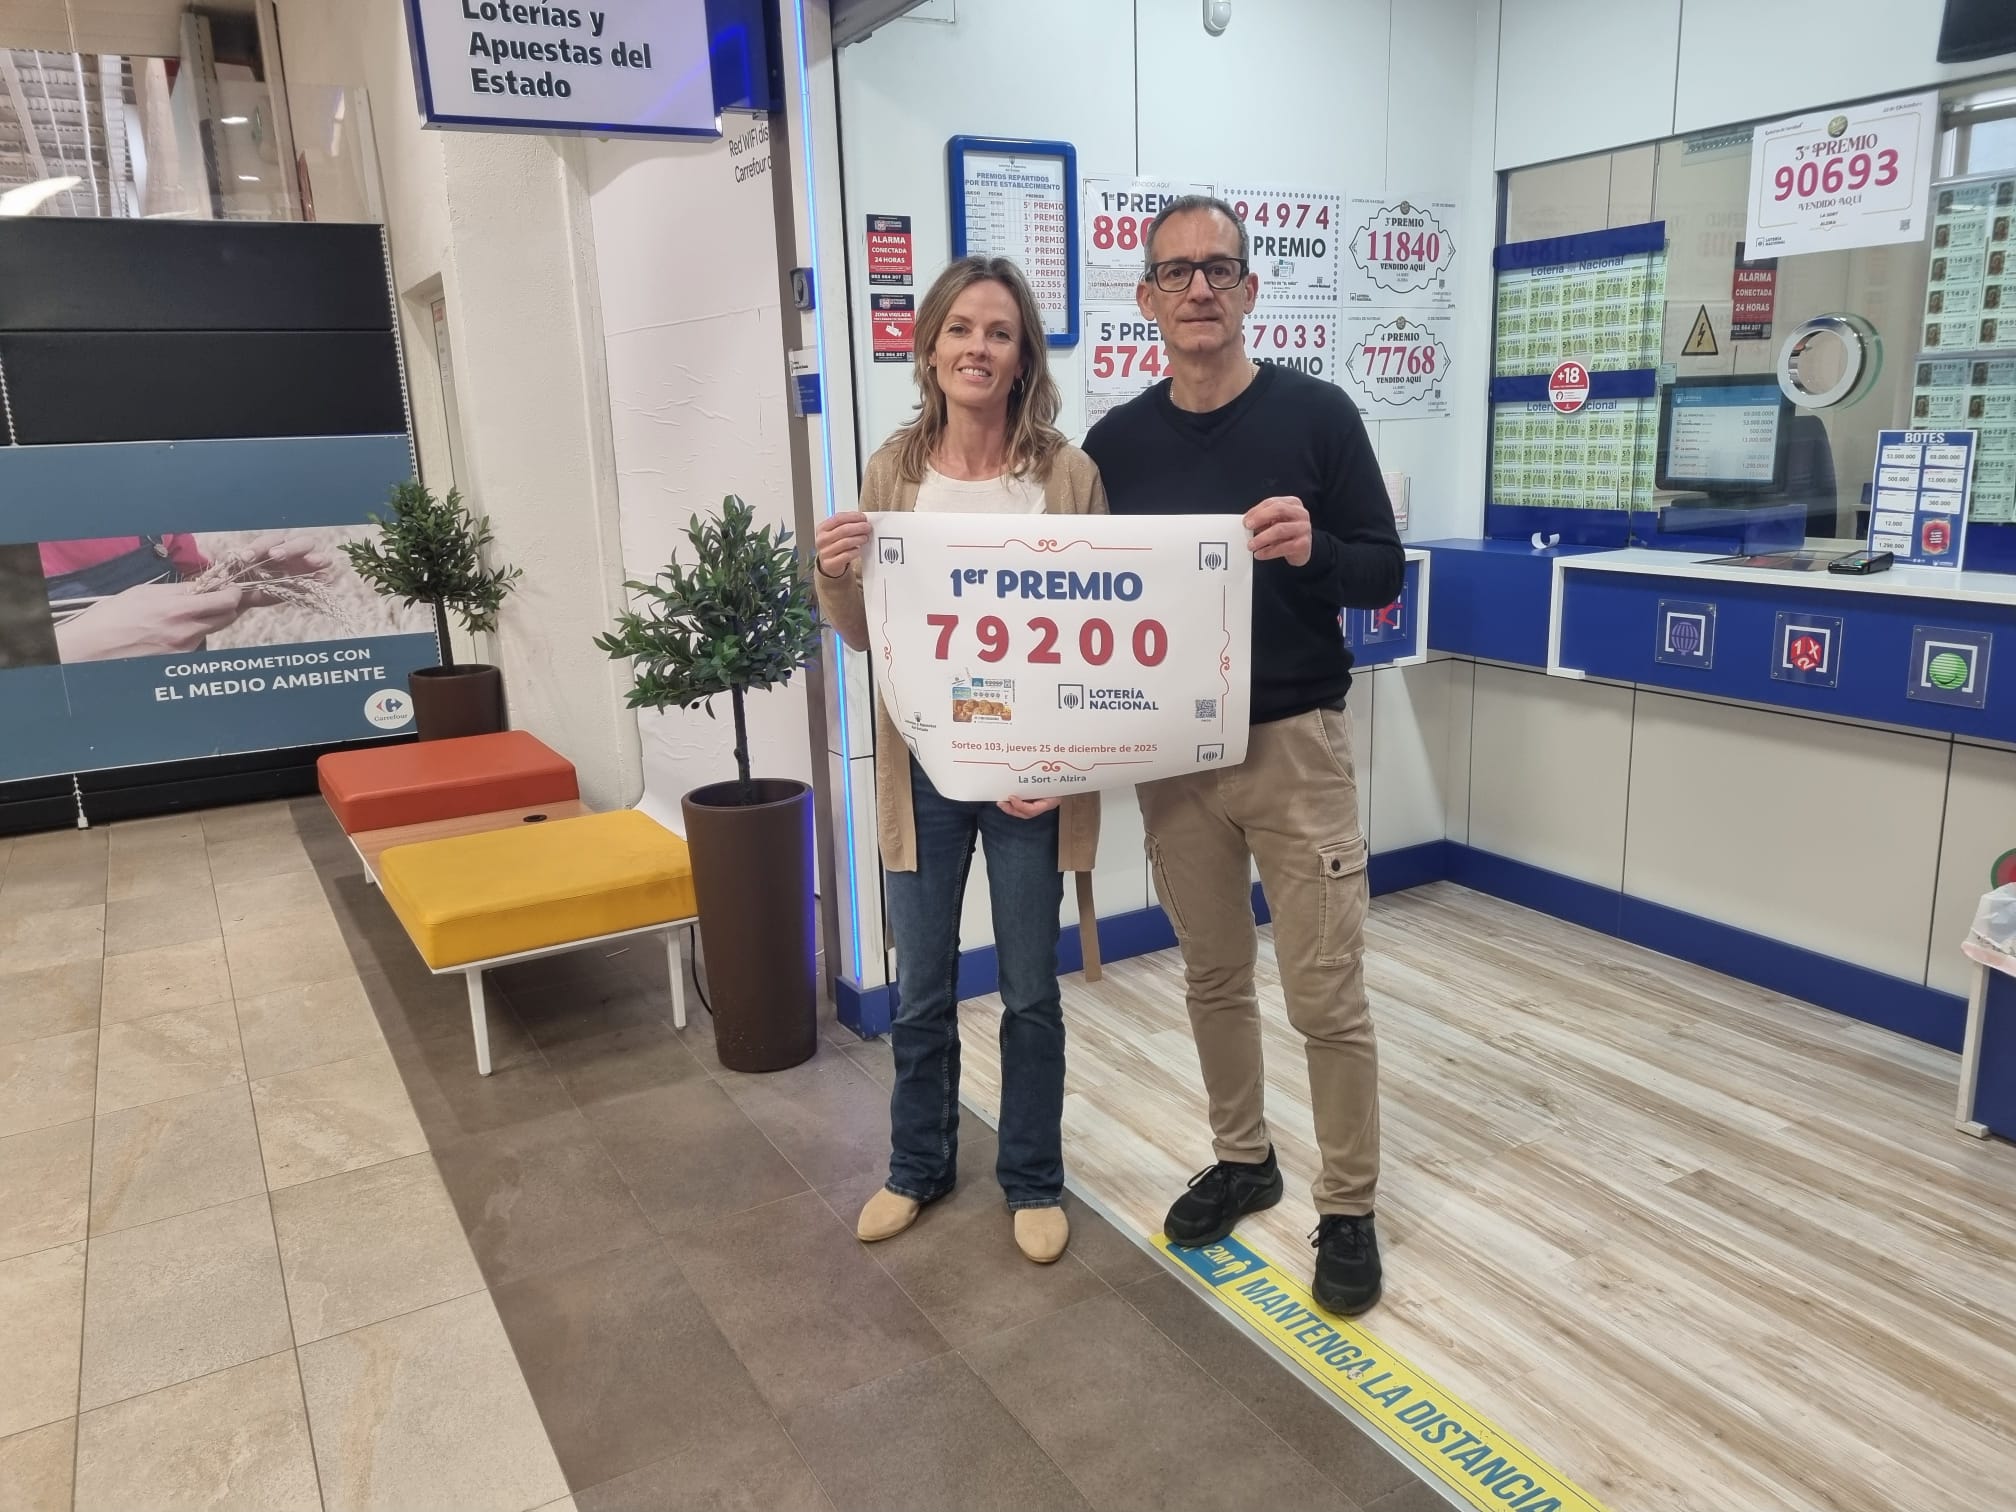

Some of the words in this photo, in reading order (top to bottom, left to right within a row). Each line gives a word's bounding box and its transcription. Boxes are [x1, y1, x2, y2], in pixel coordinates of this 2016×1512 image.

[462, 0, 582, 28] Loterías
[590, 10, 605, 36] y
[469, 31, 603, 65] Apuestas
[611, 42, 653, 69] del
[471, 68, 572, 98] Estado
[728, 133, 743, 158] Red
[1812, 133, 1878, 158] PREMIO
[735, 156, 767, 184] Carrefour
[1774, 148, 1899, 202] 90693
[976, 172, 1007, 180] PREMIOS
[1008, 174, 1050, 183] REPARTIDOS
[964, 179, 980, 187] POR
[1000, 181, 1060, 190] ESTABLECIMIENTO
[1033, 202, 1065, 211] PREMIO
[1798, 198, 1837, 212] VENDIDO
[1034, 213, 1065, 222] PREMIO
[1234, 200, 1330, 230] 94974
[1391, 217, 1424, 228] PREMIO
[1034, 225, 1065, 233] PREMIO
[872, 235, 906, 245] ALARMA
[1034, 236, 1065, 244] PREMIO
[871, 246, 907, 254] CONECTADA
[1035, 247, 1065, 255] PREMIO
[1253, 235, 1326, 258] PREMIO
[1366, 230, 1440, 263] 11840
[1035, 258, 1066, 266] PREMIO
[1380, 262, 1409, 271] VENDIDO
[1409, 261, 1426, 272] AQUÍ
[1579, 256, 1624, 271] Nacional
[1035, 269, 1066, 278] PREMIO
[1738, 272, 1772, 282] ALARMA
[1031, 280, 1061, 288] 122.555
[1735, 288, 1773, 297] CONECTADA
[1735, 303, 1745, 312] 24
[1745, 303, 1770, 312] HORAS
[1242, 324, 1326, 350] 7033
[1387, 332, 1420, 342] PREMIO
[1362, 345, 1435, 377] 77768
[1405, 375, 1422, 385] AQUÍ
[1557, 367, 1580, 384] +18
[1584, 399, 1617, 411] cional
[1904, 432, 1945, 444] BOTES
[950, 568, 988, 598] 1er
[996, 569, 1144, 601] PREMIO
[926, 612, 1169, 667] 79200
[164, 650, 329, 678] COMPROMETIDOS
[333, 647, 371, 663] CON
[155, 684, 184, 702] EL
[188, 676, 266, 698] MEDIO
[271, 664, 386, 691] AMBIENTE
[1089, 687, 1145, 699] LOTERÍA
[1089, 699, 1160, 712] NACIONAL
[373, 712, 408, 723] Carrefour
[951, 740, 983, 752] Sorteo
[984, 741, 1004, 753] 103,
[1005, 741, 1037, 755] jueves
[1039, 742, 1052, 753] 25
[1054, 741, 1066, 753] de
[1068, 741, 1117, 754] diciembre
[1118, 741, 1132, 753] de
[1134, 743, 1158, 753] 2025
[1018, 774, 1030, 784] La
[1031, 774, 1052, 784] Sort
[1059, 773, 1087, 783] Alzira
[1203, 1245, 1236, 1265] 2M
[1236, 1276, 1377, 1380] MANTENGA
[1359, 1372, 1414, 1410] LA
[1395, 1399, 1563, 1512] DISTANCIA
